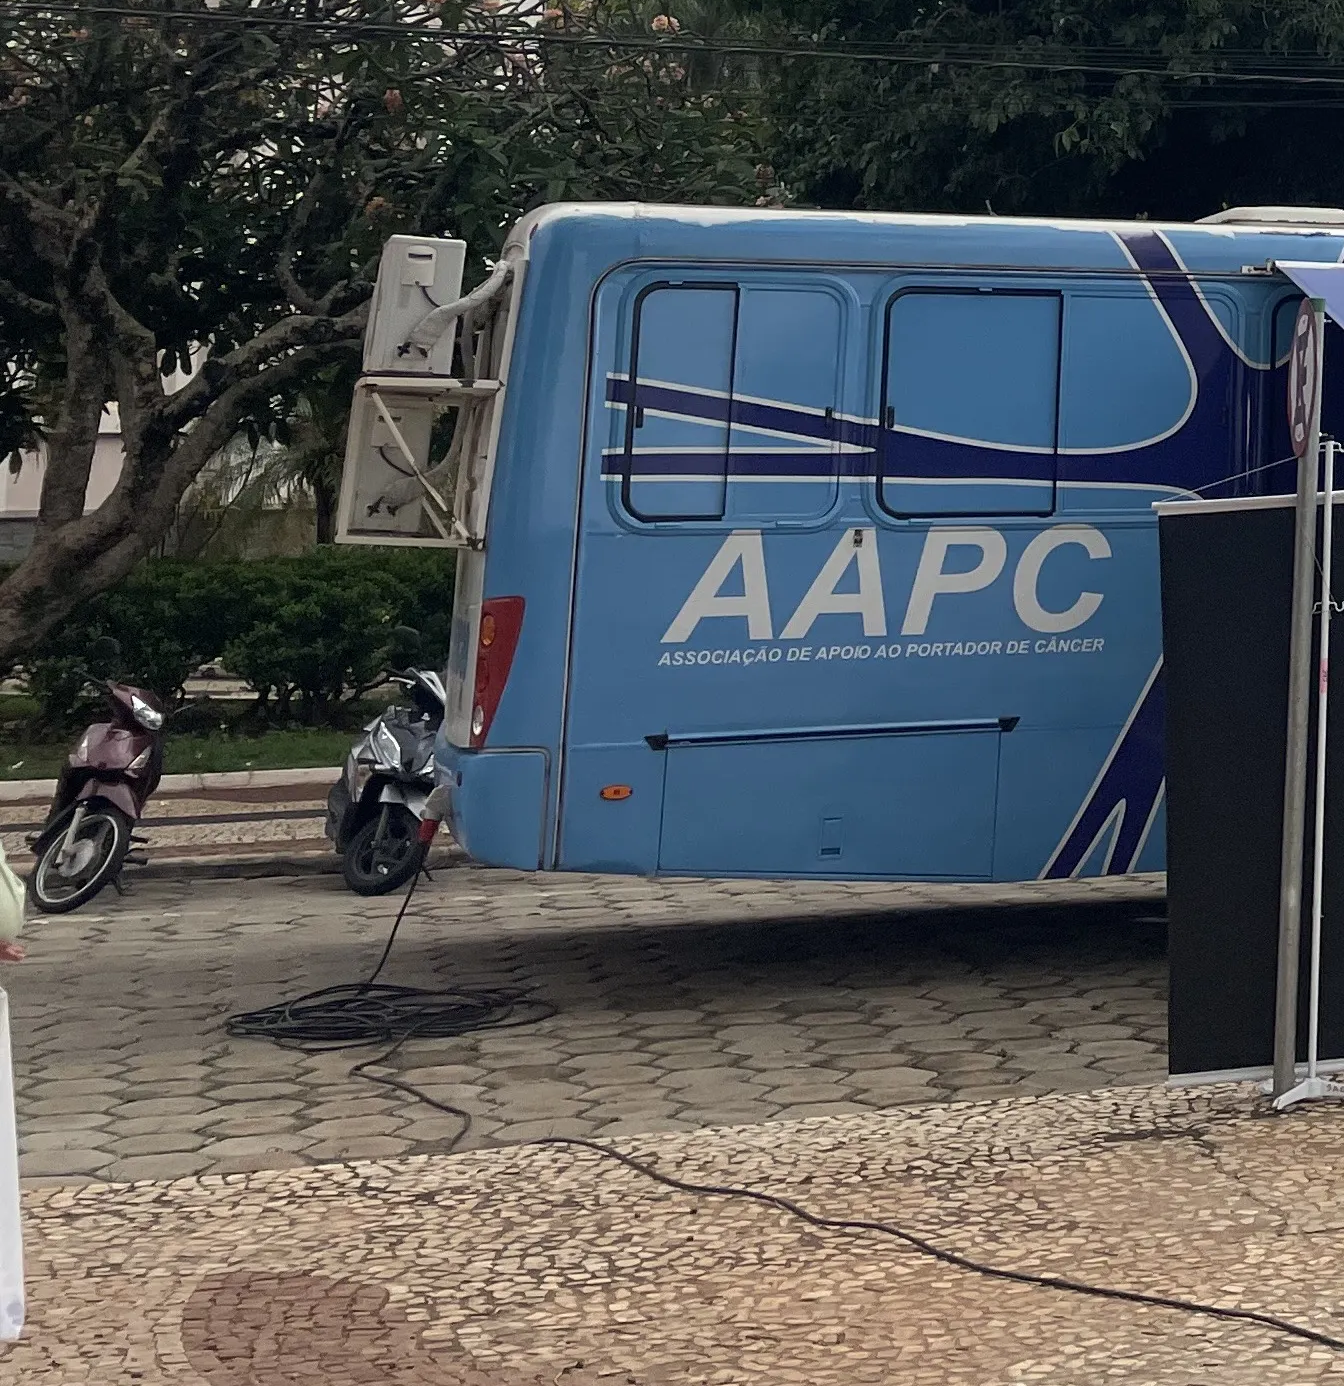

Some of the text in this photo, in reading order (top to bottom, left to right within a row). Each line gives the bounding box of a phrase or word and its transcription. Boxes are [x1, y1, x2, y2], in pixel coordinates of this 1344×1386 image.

[660, 523, 1112, 643] AAPC
[658, 636, 1104, 666] ASSOCIAÇÃO DE APOIO AO PORTADOR DE CÂNCER
